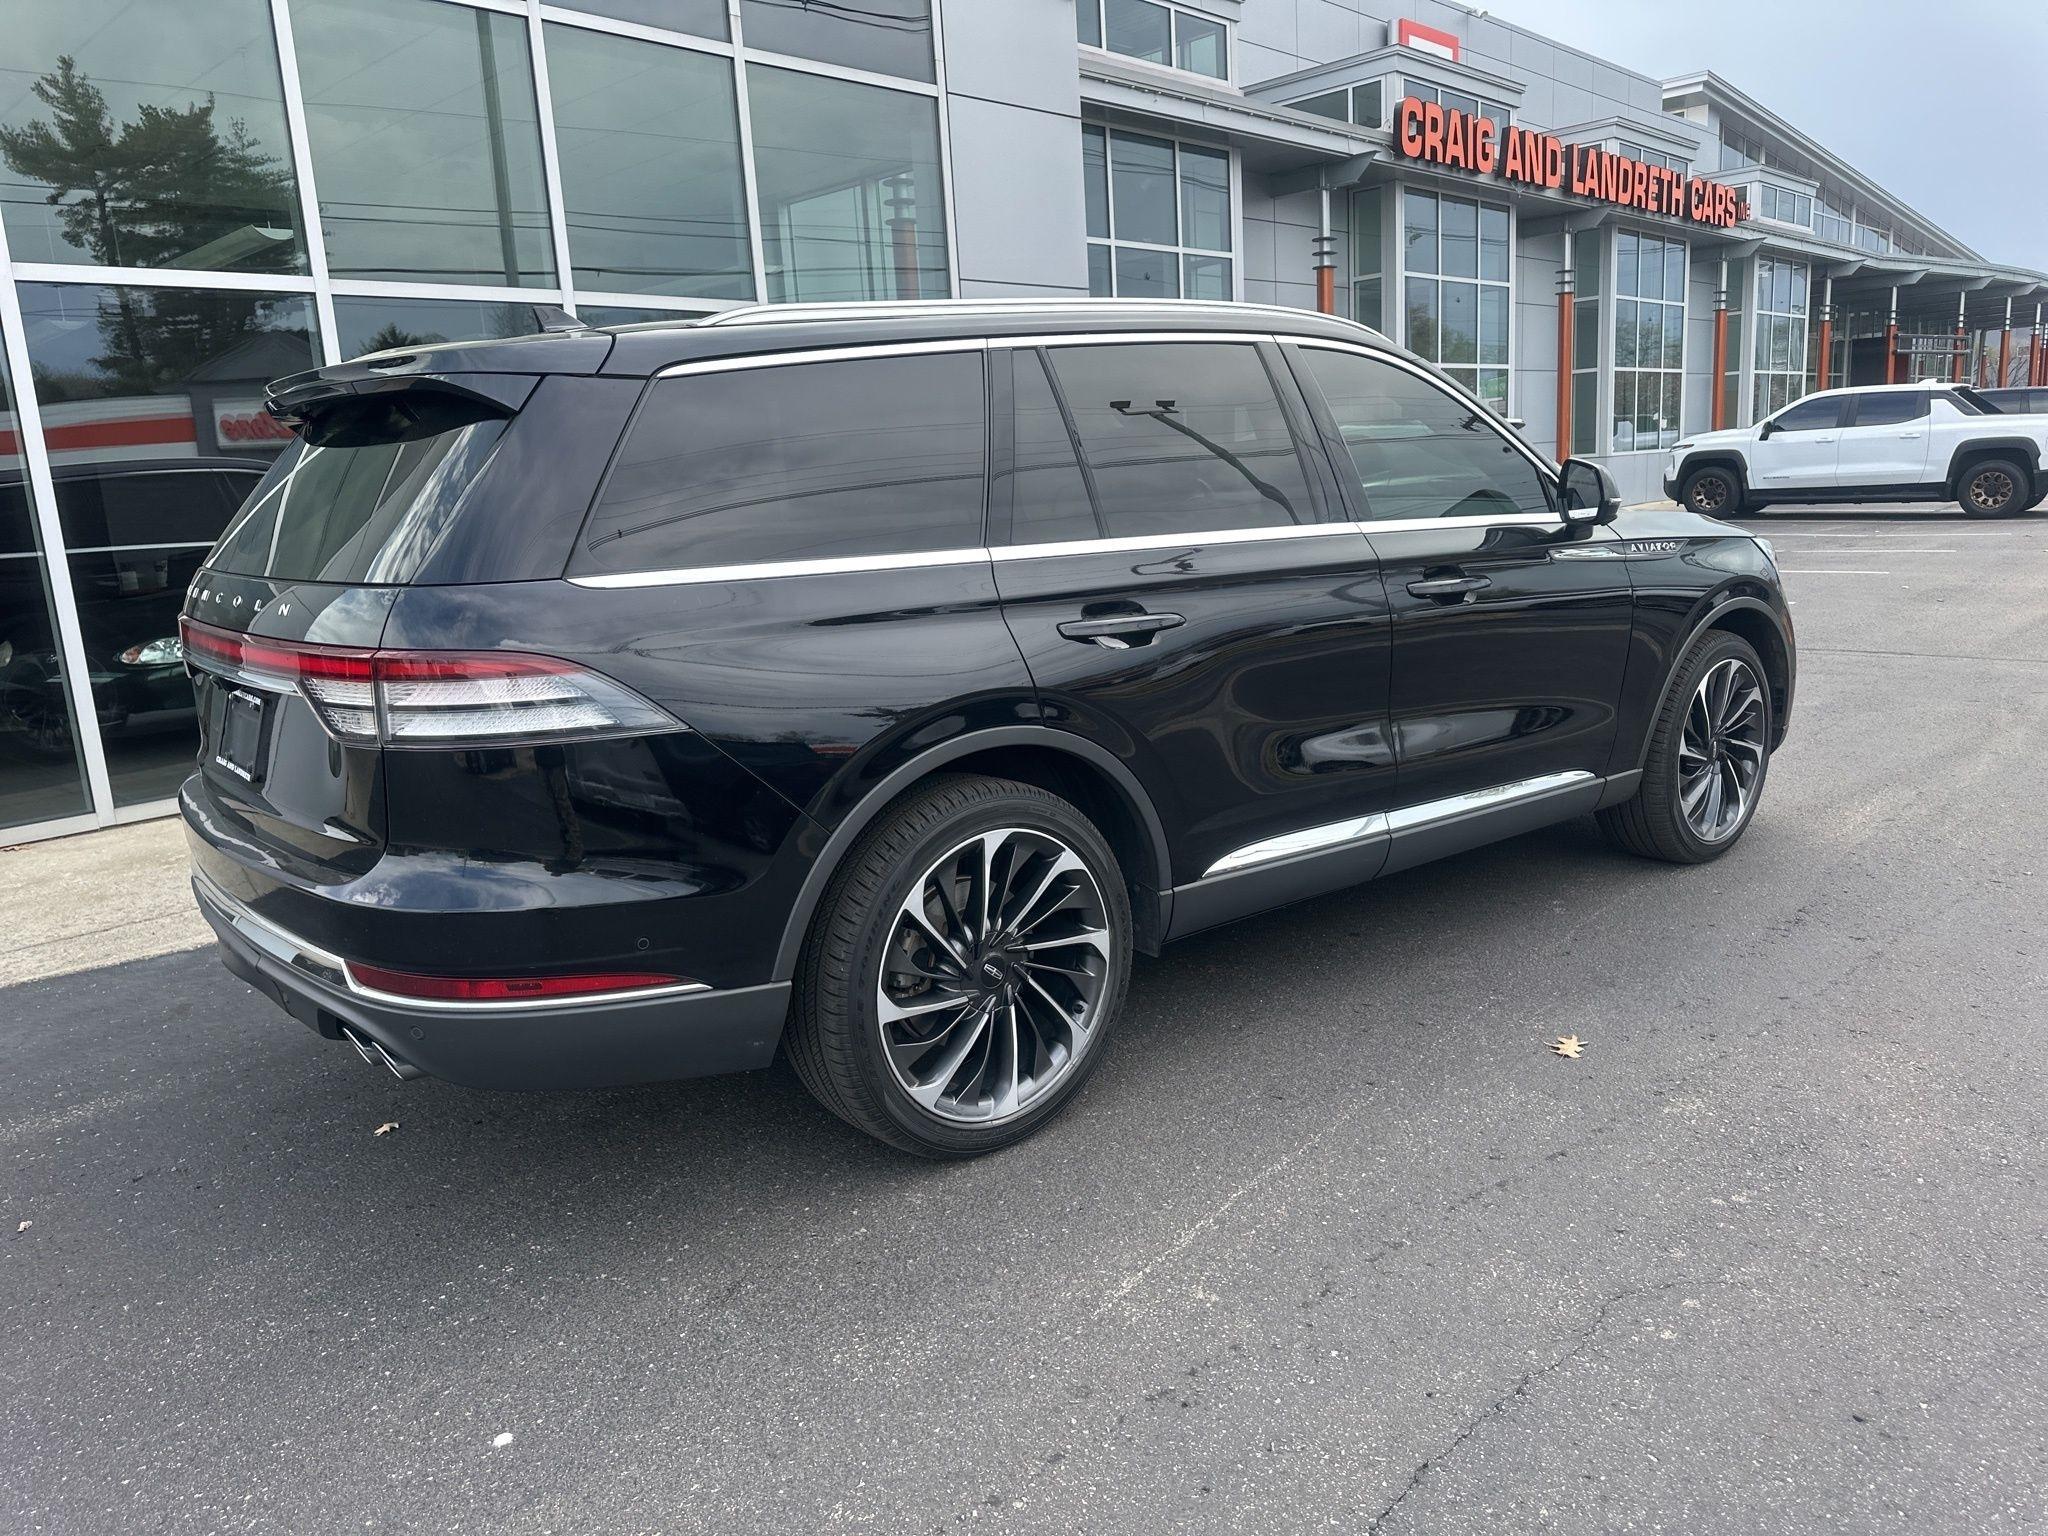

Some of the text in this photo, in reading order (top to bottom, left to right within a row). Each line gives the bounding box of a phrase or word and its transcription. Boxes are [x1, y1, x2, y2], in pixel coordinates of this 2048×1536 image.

[1399, 95, 1495, 174] CRAIG
[1504, 125, 1562, 189] AND
[1571, 143, 1686, 217] LANDRETH
[1691, 177, 1736, 228] CARS
[1631, 542, 1677, 553] AVIATOR
